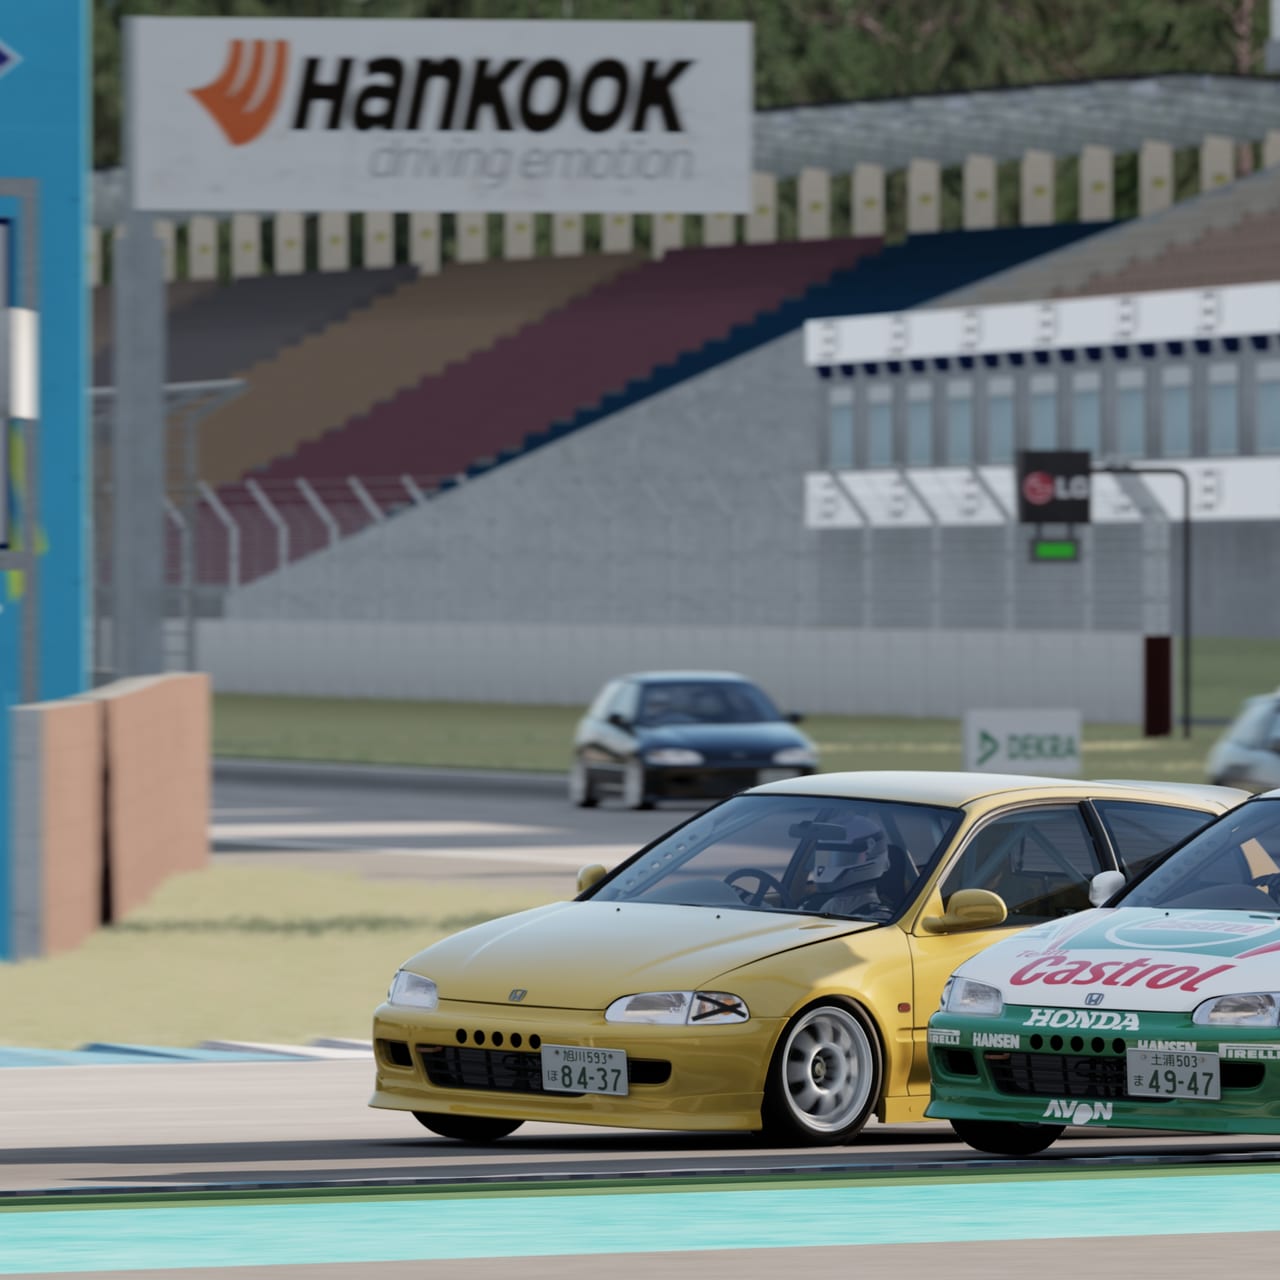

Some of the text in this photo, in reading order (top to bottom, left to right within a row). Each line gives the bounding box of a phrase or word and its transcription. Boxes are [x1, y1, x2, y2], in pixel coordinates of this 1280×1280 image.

[368, 138, 694, 188] driving emotion
[1007, 733, 1078, 760] DEKRA
[1009, 955, 1237, 993] Castrol
[1022, 1009, 1140, 1031] HONDA
[972, 1032, 1020, 1049] HANSEN
[561, 1065, 621, 1092] 84-37
[1149, 1069, 1214, 1096] 49-47
[1043, 1099, 1113, 1125] AVON
